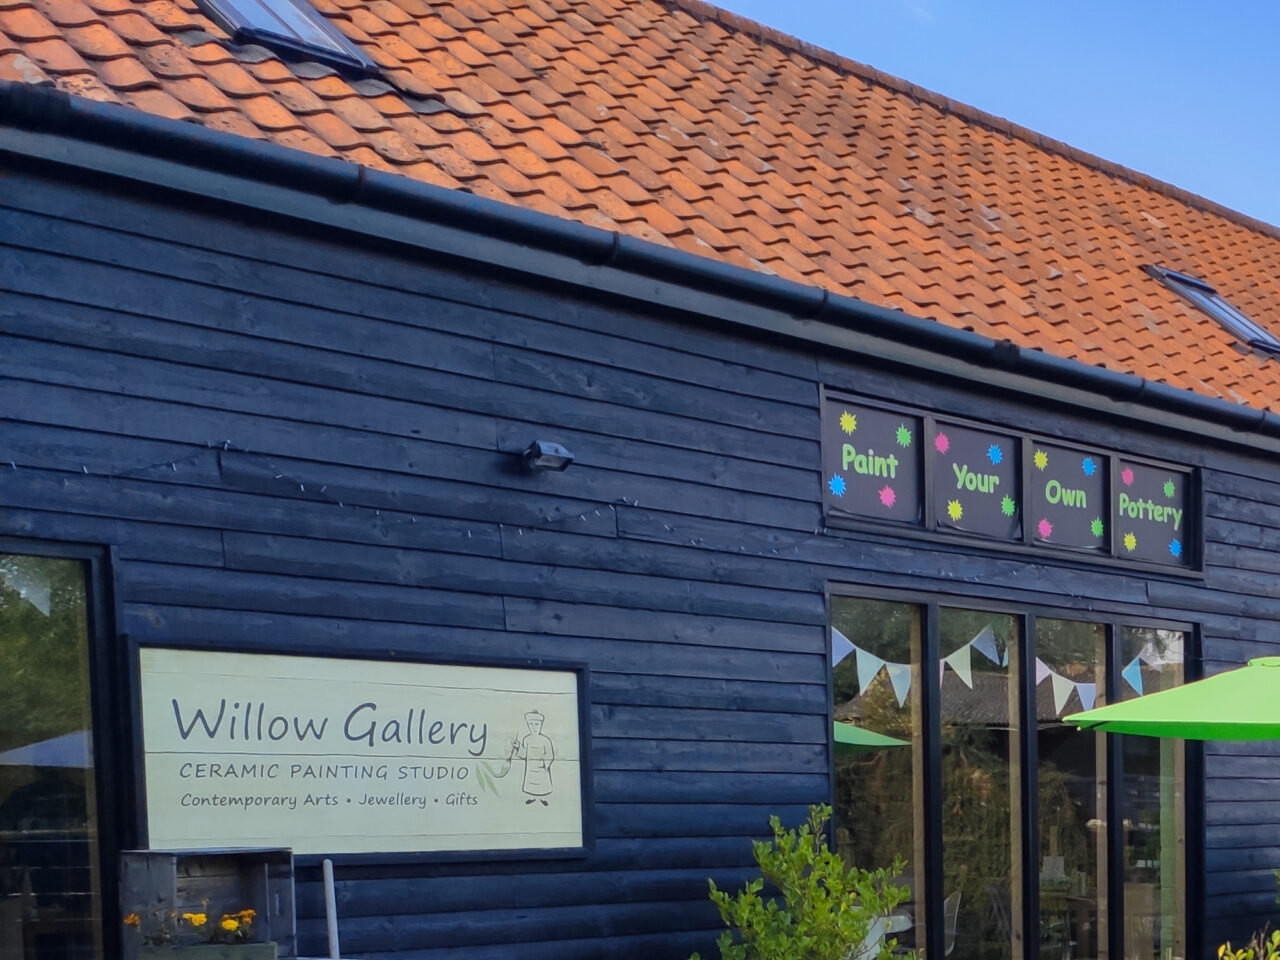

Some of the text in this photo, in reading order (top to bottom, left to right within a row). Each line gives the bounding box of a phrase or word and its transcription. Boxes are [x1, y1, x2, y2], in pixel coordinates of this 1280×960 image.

[841, 443, 1183, 531] Paint Your Own Pottery
[171, 698, 489, 757] Willow Gallery
[179, 762, 470, 781] CERAMIC PAINTING STUDIO
[180, 792, 479, 812] Contemporary Arts Jewellery Gifts
